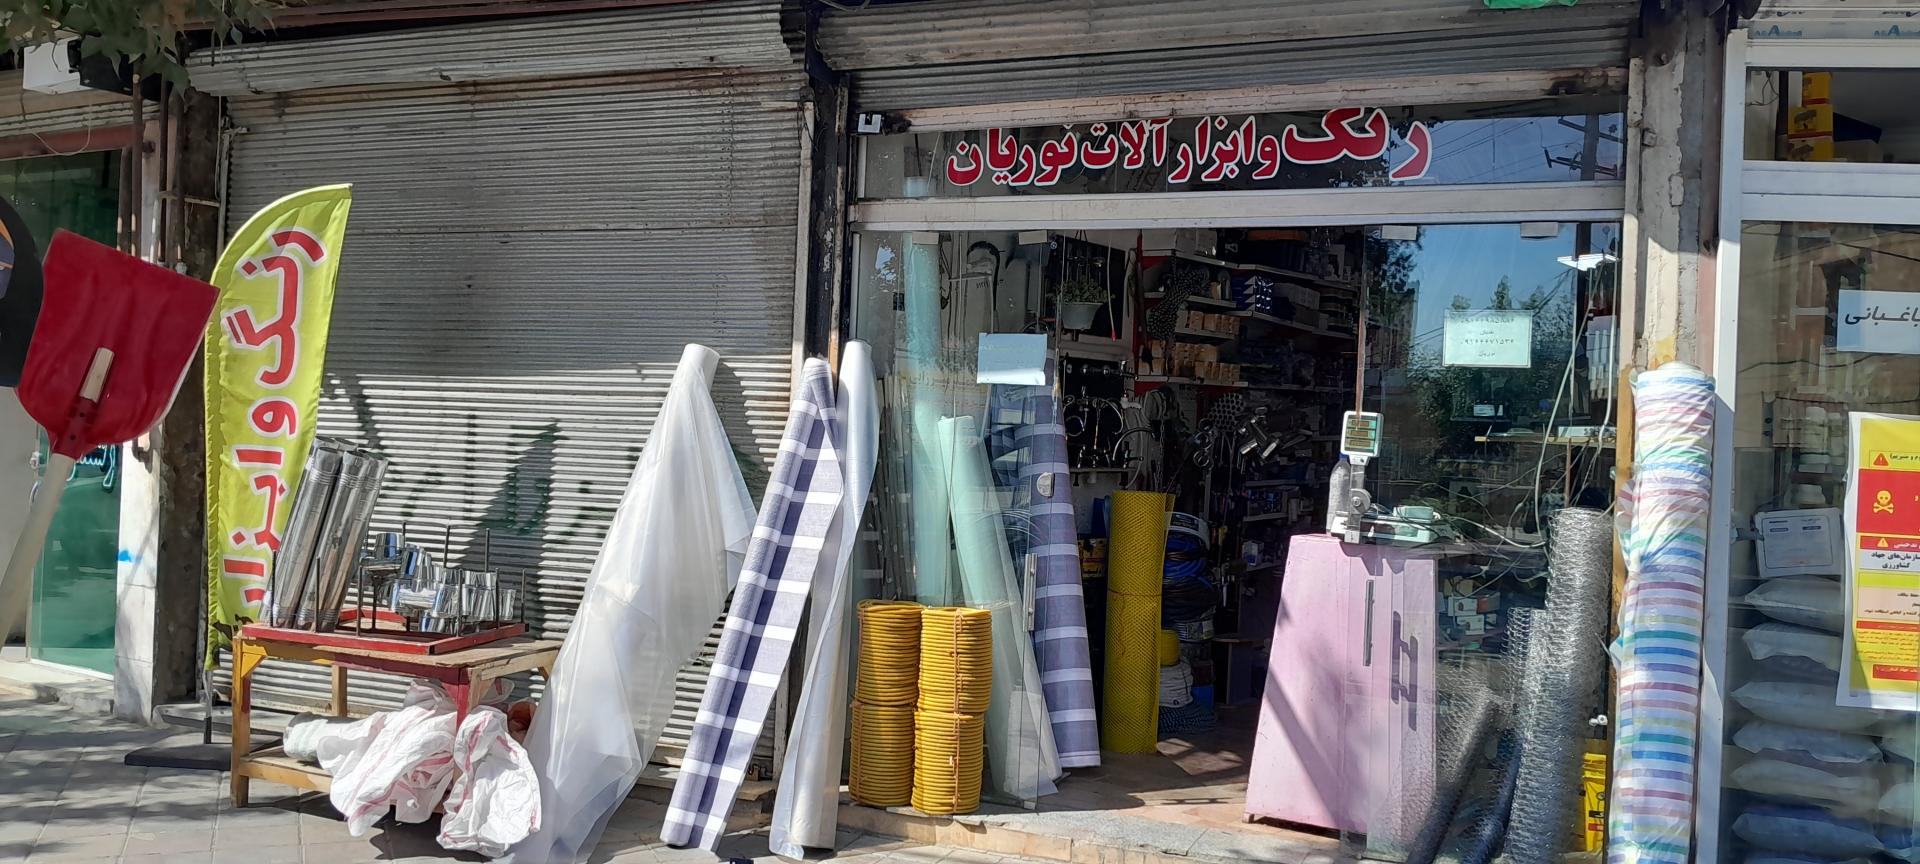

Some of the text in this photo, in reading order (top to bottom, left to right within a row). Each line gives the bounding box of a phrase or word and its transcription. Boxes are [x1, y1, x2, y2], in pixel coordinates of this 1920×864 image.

[946, 106, 1432, 186] رنگ و ابزار آلات نوریان
[222, 227, 328, 390] رنگ
[249, 397, 299, 439] و
